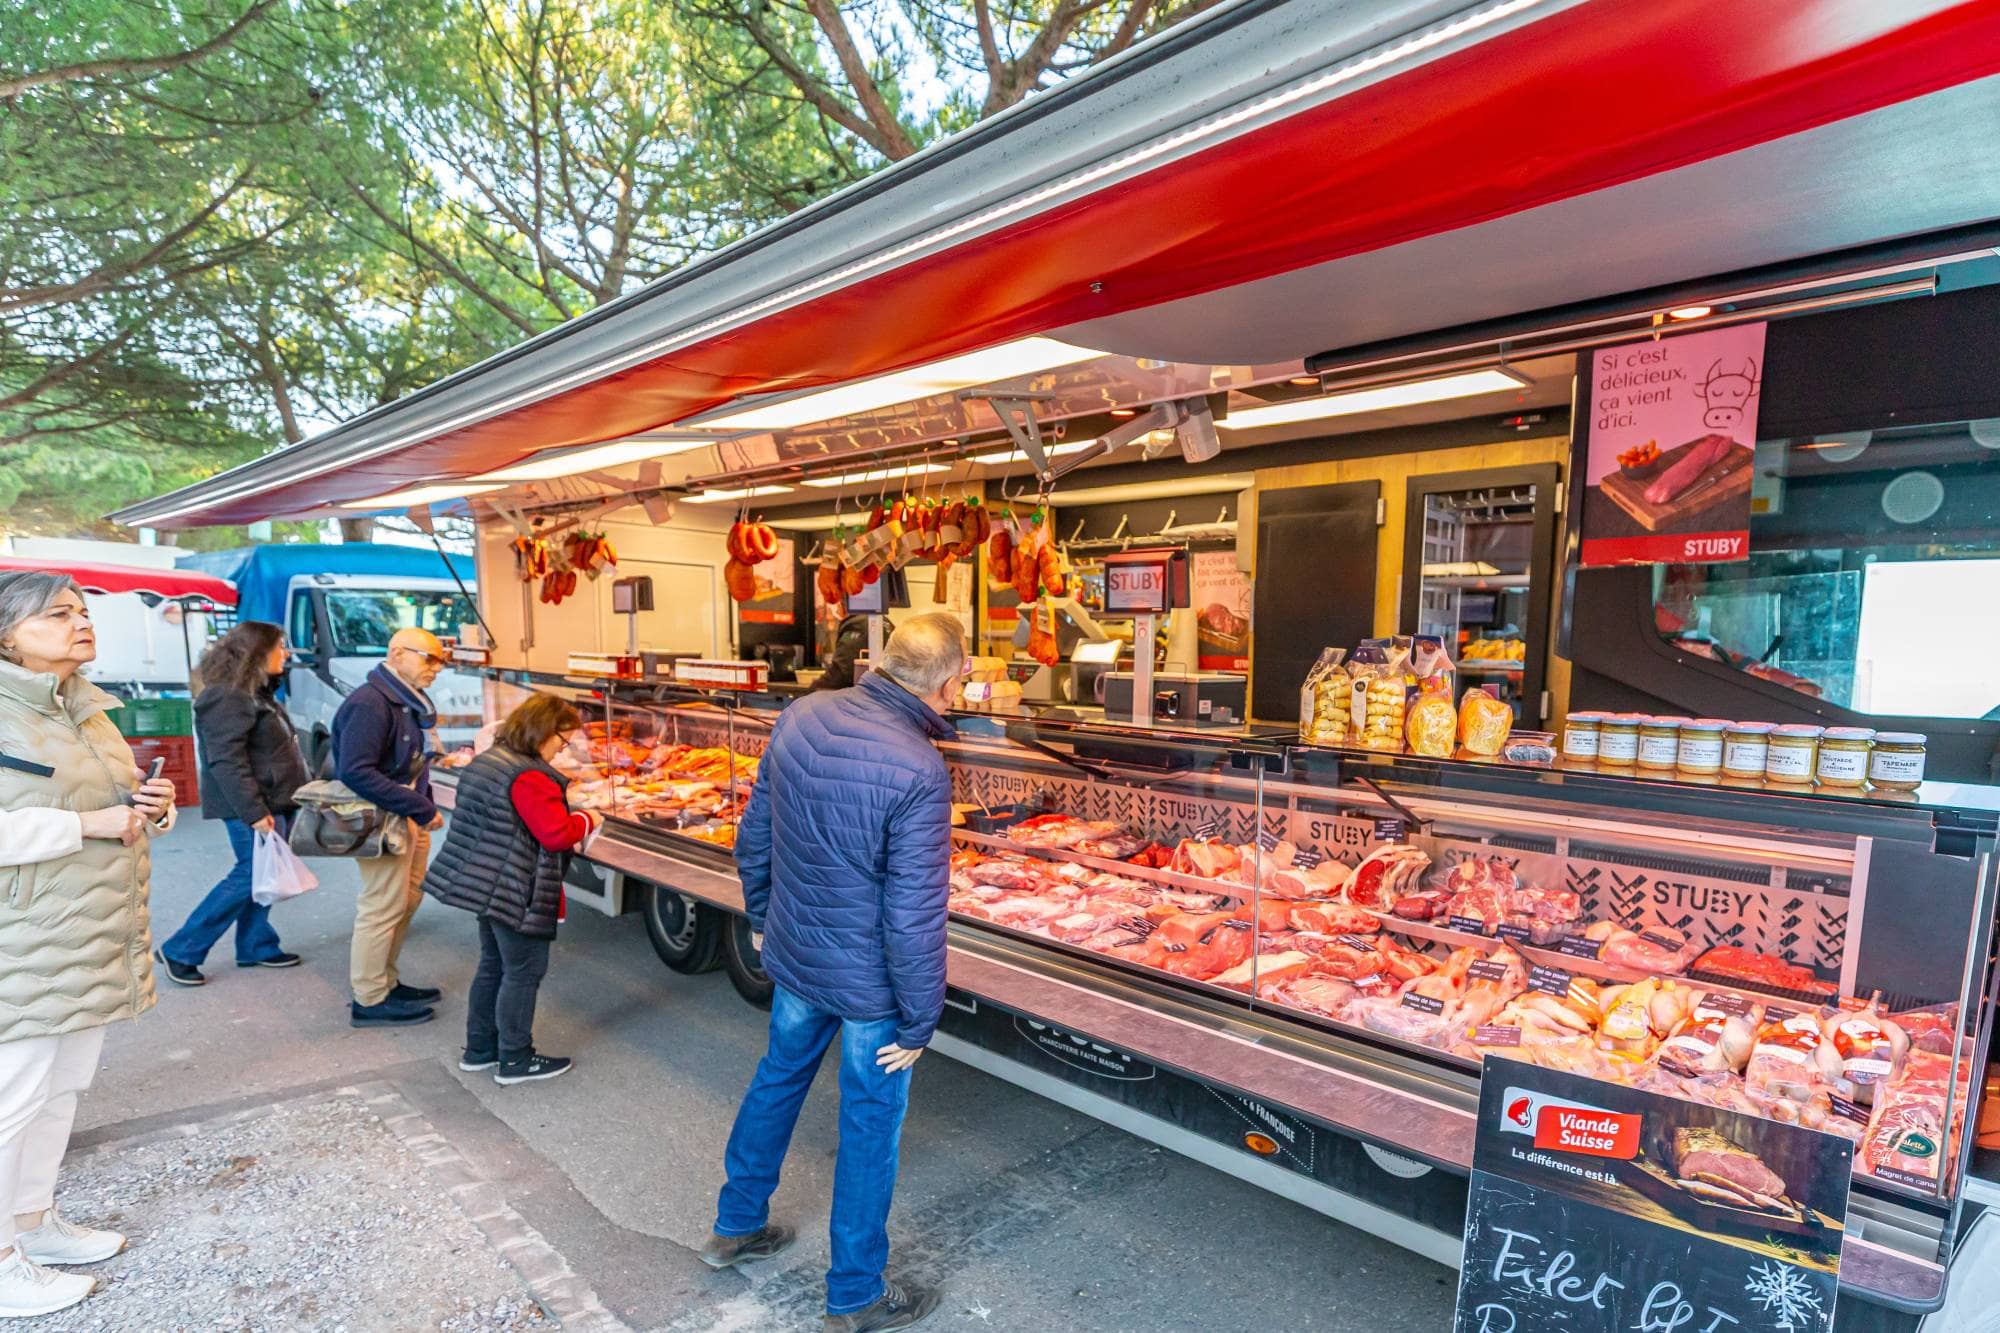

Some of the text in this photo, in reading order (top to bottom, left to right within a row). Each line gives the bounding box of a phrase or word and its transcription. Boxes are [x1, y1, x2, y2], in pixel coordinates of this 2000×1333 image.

[1601, 347, 1668, 371] Si c'est
[1600, 366, 1687, 391] délicieux,
[1599, 387, 1672, 412] ça vient
[1598, 413, 1637, 430] d'ici.
[1684, 538, 1742, 556] STUBY
[1110, 572, 1163, 591] STUBY
[992, 774, 1030, 793] STUBY
[1159, 799, 1208, 820] STUBY
[1310, 820, 1373, 848] STUBY
[1653, 880, 1753, 918] STUBY
[1712, 994, 1743, 1004] Poulet
[1038, 1035, 1079, 1056] CHARCUTERIE
[1079, 1047, 1098, 1063] FAITE
[1098, 1056, 1125, 1073] MAISON
[1255, 1104, 1296, 1144] FRANÇOISE
[1559, 1112, 1620, 1135] Viande
[1559, 1130, 1615, 1150] Suisse
[1511, 1147, 1620, 1187] La différence est là.
[1876, 1167, 1937, 1189] Magret de cana
[1491, 1225, 1625, 1309] Filet
